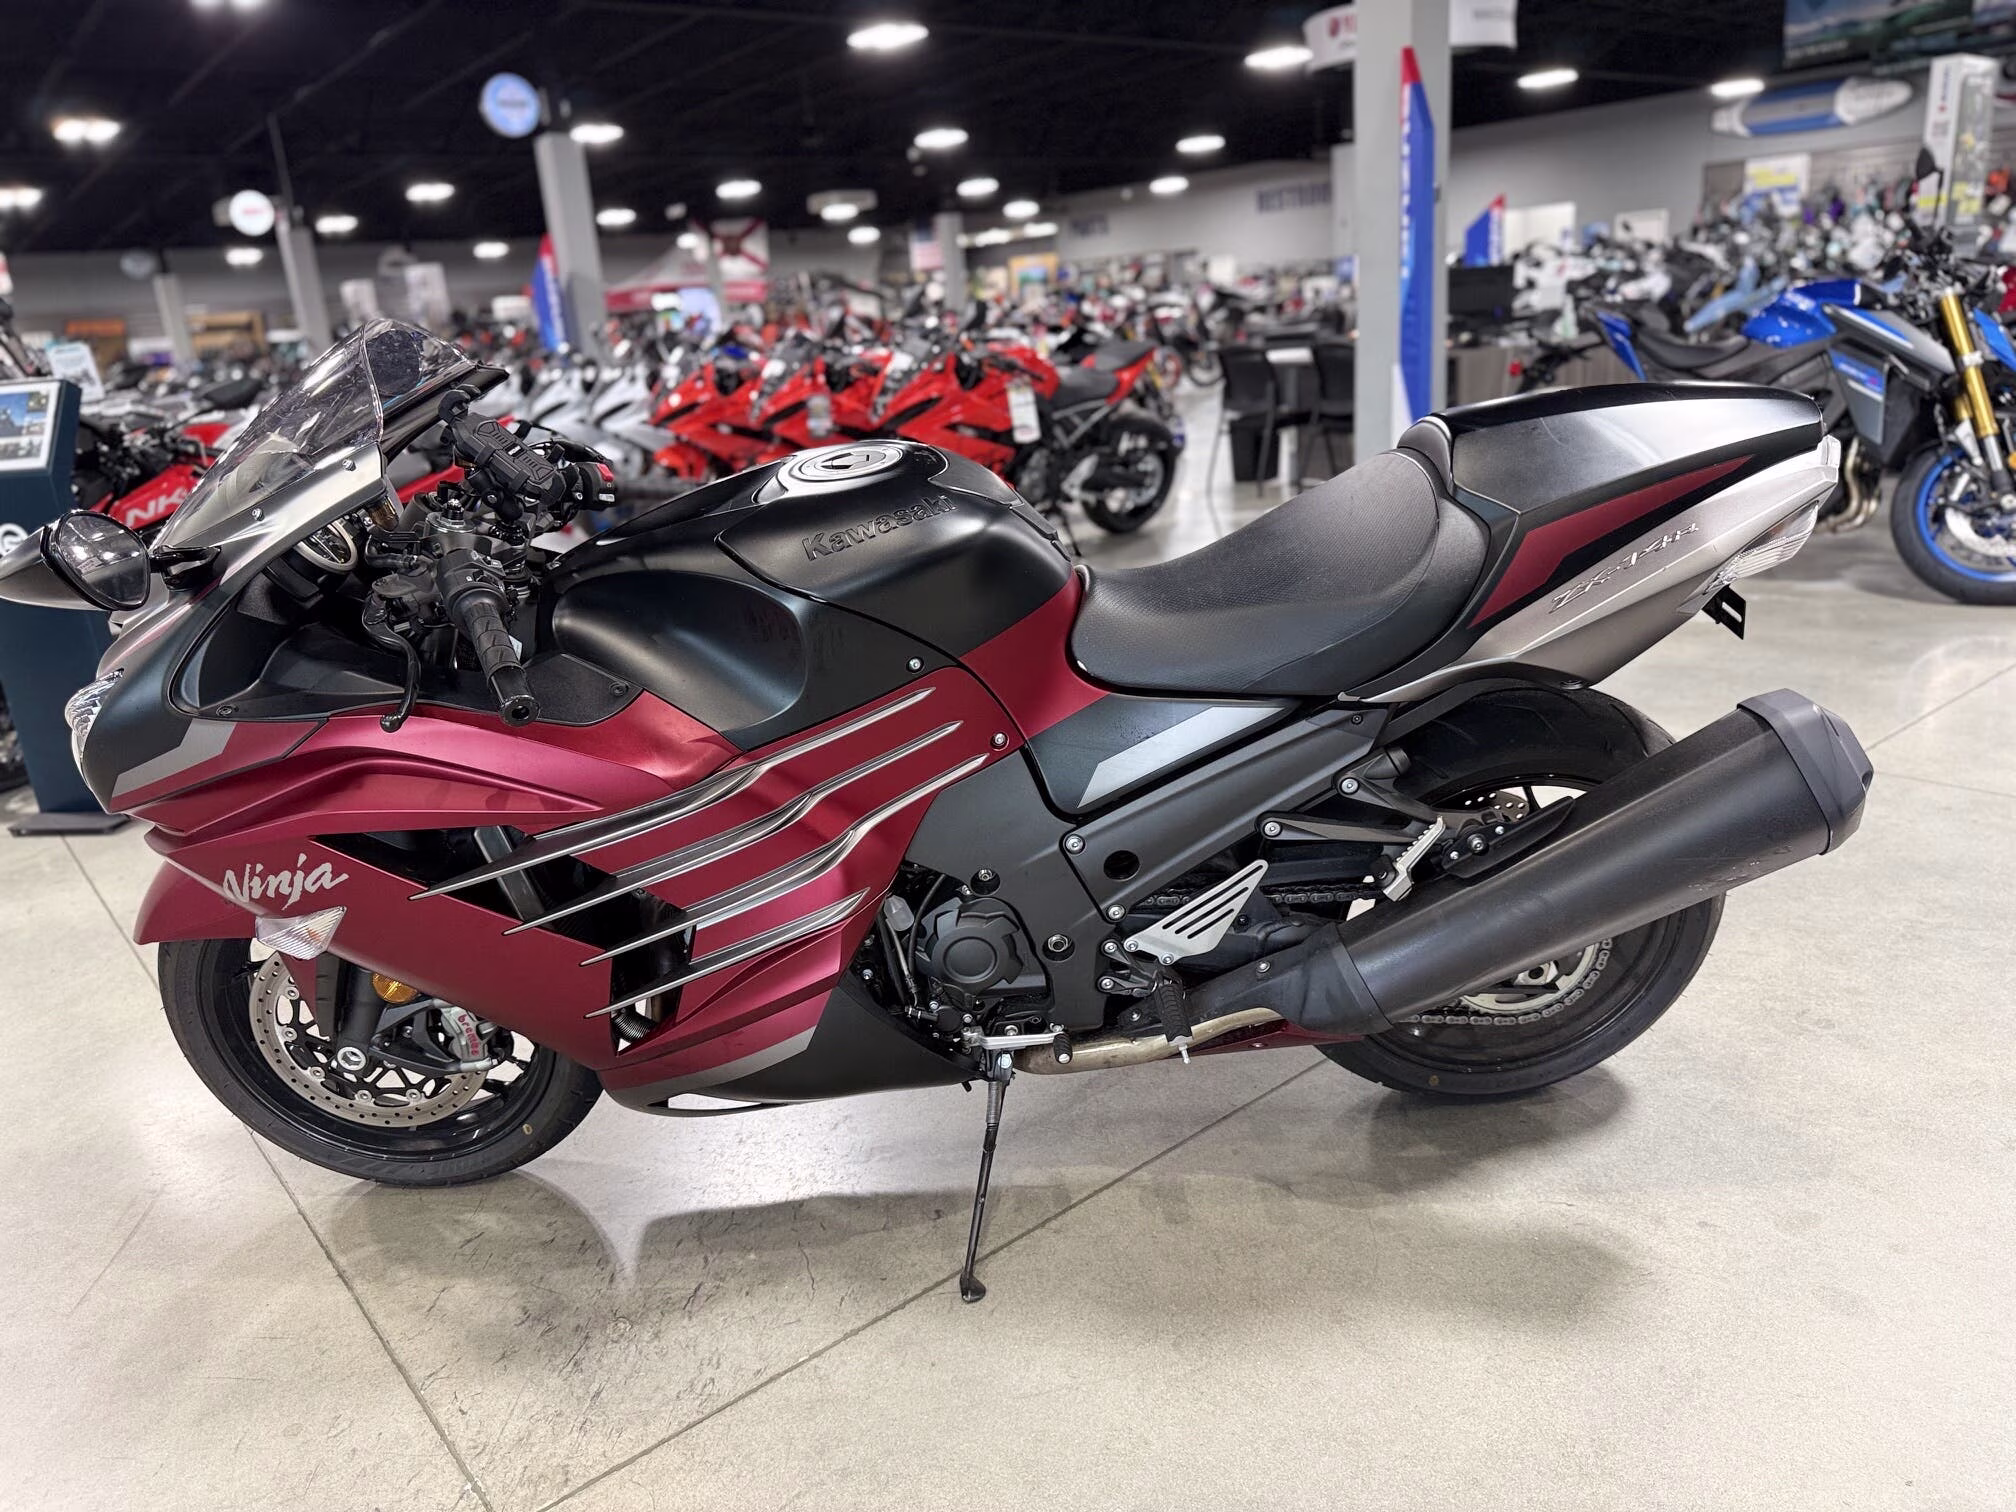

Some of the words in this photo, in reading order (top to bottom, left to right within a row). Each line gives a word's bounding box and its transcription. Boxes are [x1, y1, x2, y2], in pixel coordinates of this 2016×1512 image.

[801, 494, 957, 561] Kawasaki
[1549, 523, 1699, 614] ZX-14R
[222, 852, 350, 911] Ninja
